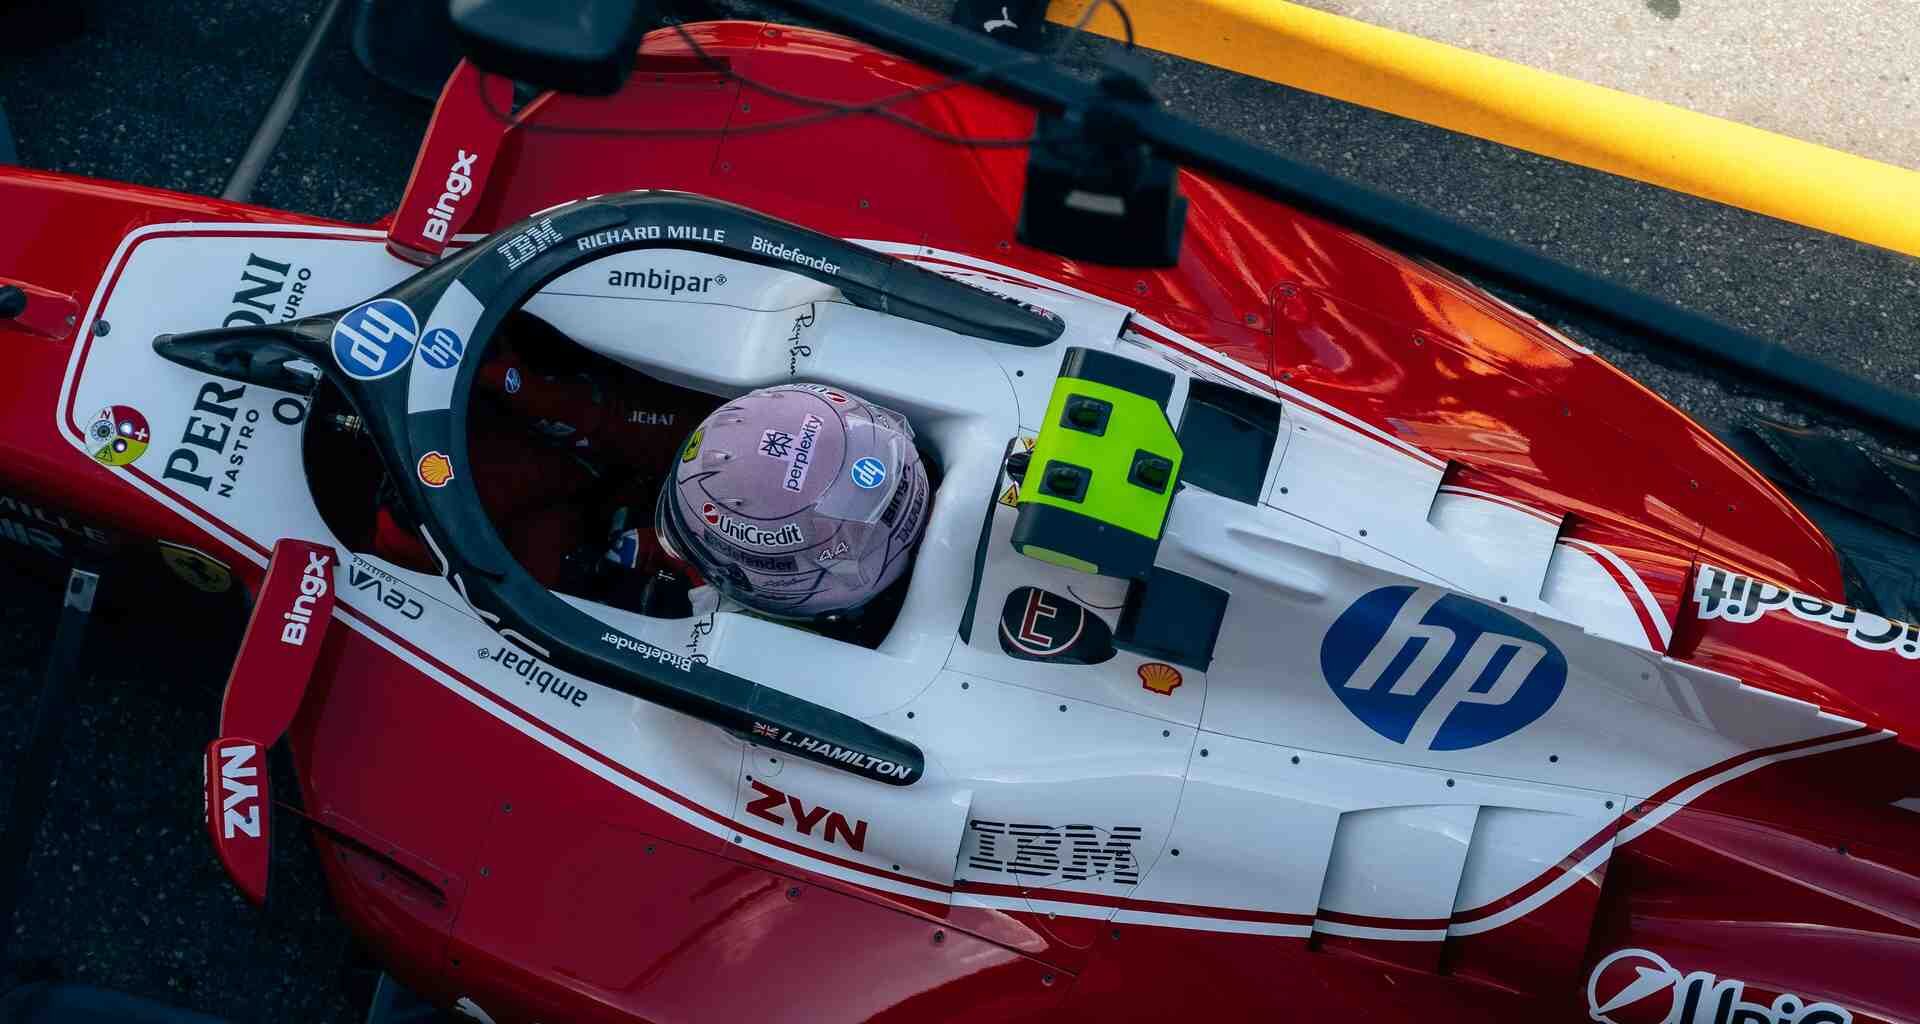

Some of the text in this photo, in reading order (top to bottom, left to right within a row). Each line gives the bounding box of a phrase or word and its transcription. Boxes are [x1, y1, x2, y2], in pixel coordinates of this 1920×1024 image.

[497, 218, 563, 270] IBM
[577, 225, 725, 250] RICHARD MILLE
[752, 235, 840, 275] Bitdefender
[608, 269, 713, 295] ambipar
[419, 329, 462, 368] hp
[217, 409, 260, 498] NASTRO
[786, 415, 823, 492] perplexity
[719, 516, 803, 546] UniCredit
[490, 647, 588, 708] ambipar
[601, 630, 693, 673] Bitdefender
[1343, 586, 1550, 750] hp
[780, 731, 913, 780] L.HAMILTON
[219, 744, 261, 839] ZYN
[746, 779, 868, 853] ZYN
[968, 819, 1142, 885] IBM
